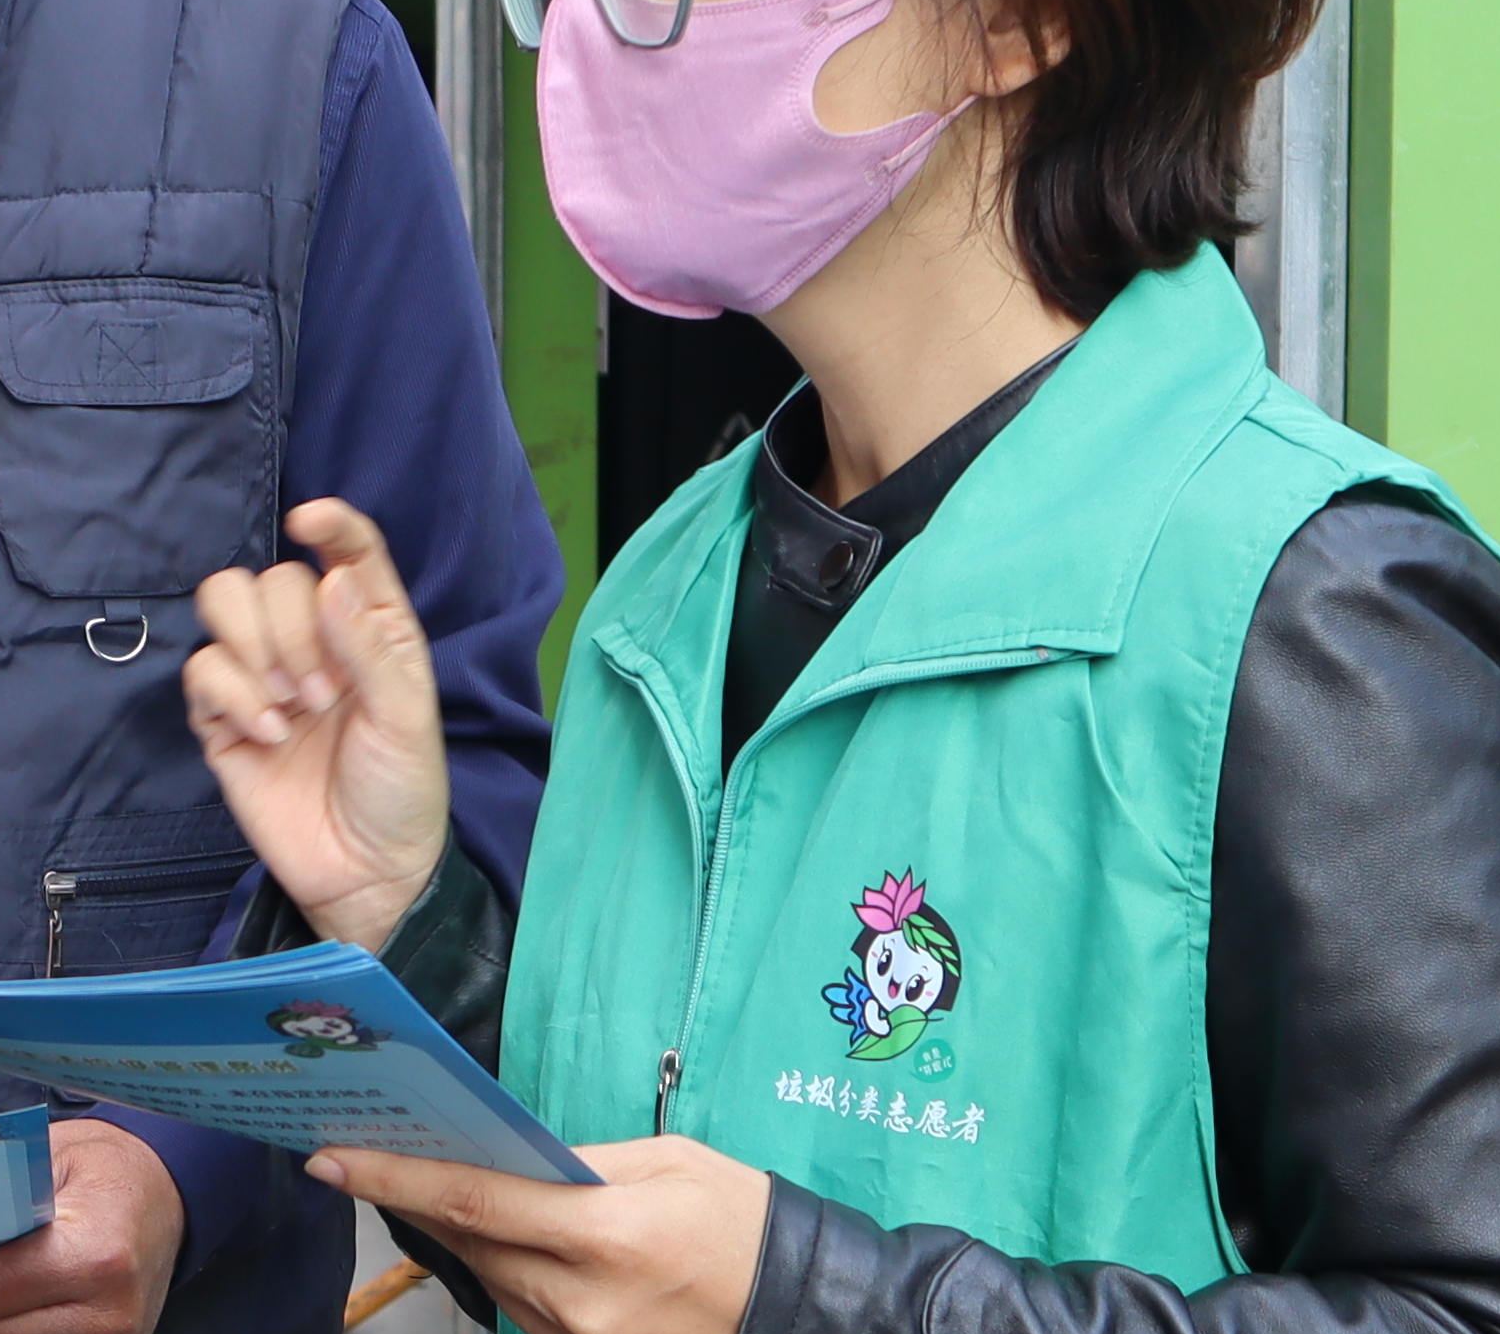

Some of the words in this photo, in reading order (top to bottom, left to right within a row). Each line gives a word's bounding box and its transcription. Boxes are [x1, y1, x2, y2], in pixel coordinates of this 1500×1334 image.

[774, 1069, 986, 1144] 垃圾分类志愿者
